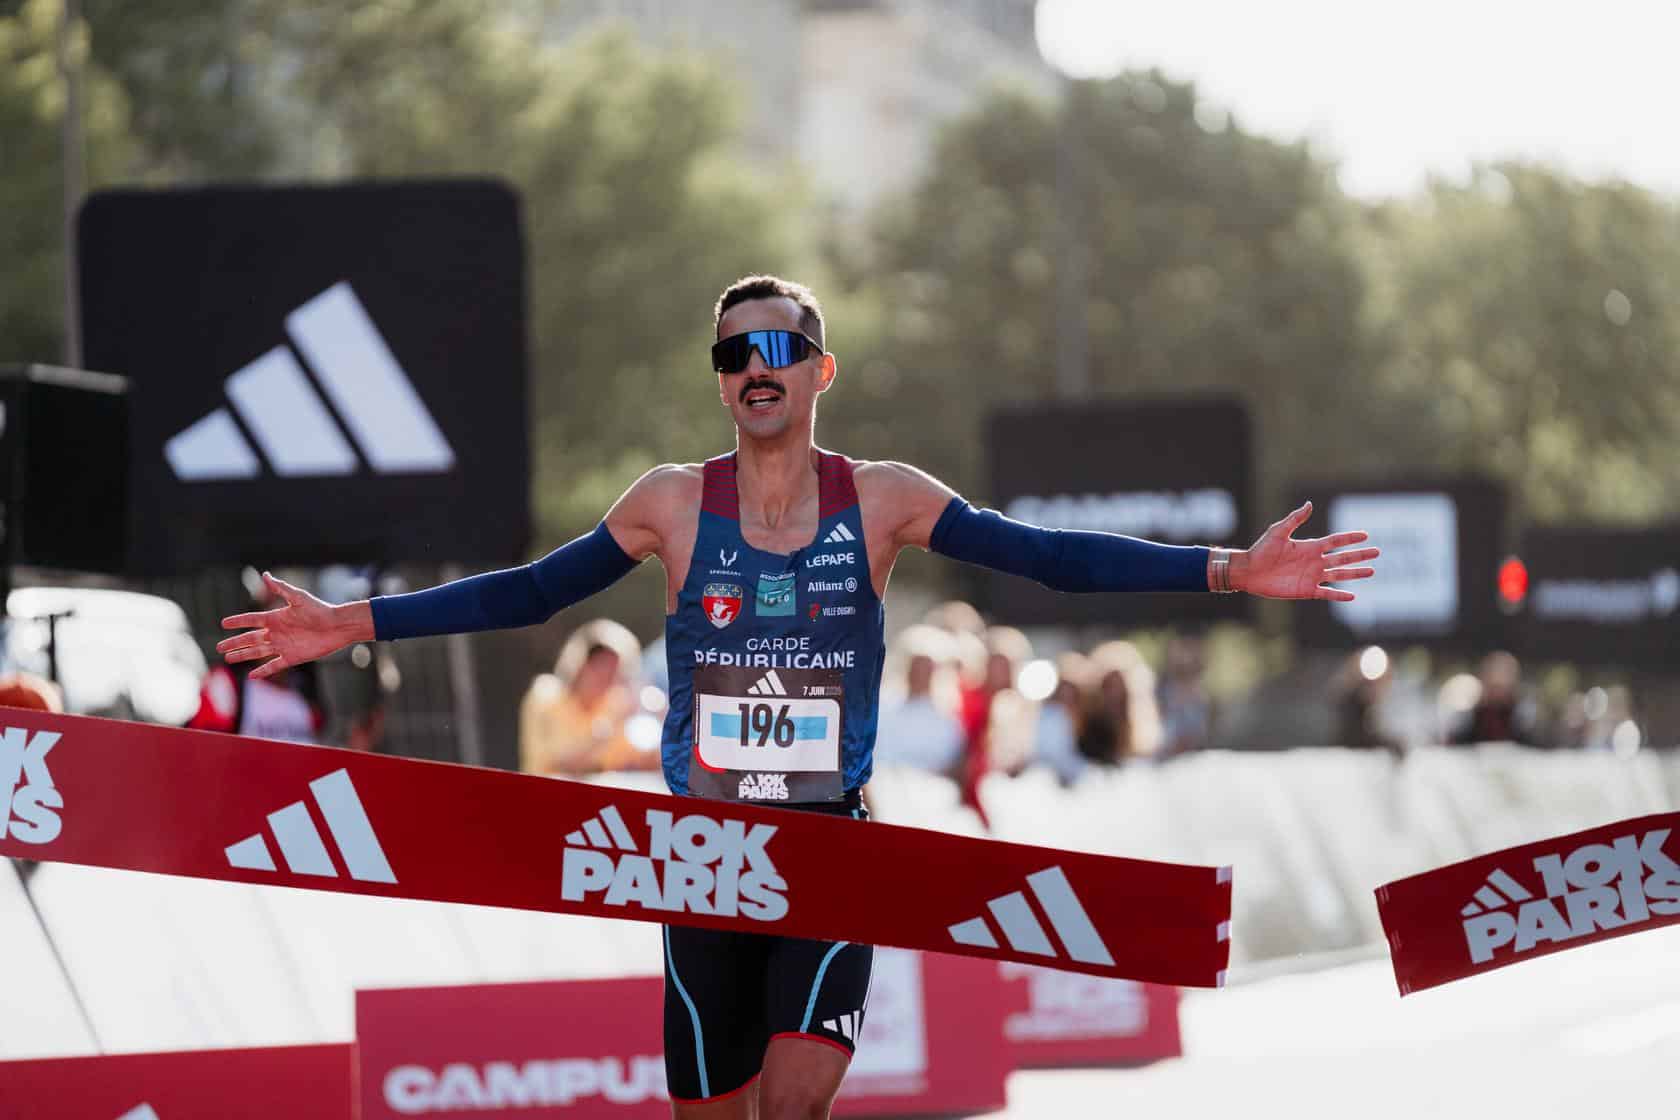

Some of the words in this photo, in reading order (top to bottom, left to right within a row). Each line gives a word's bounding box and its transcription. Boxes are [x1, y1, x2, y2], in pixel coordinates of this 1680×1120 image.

[806, 553, 855, 568] LEPAPE
[807, 581, 844, 593] Allianz
[746, 637, 810, 651] GARDE
[737, 703, 796, 748] 196
[738, 785, 789, 800] PARIS
[757, 774, 788, 787] 10K
[646, 809, 779, 874] 10K
[1533, 828, 1680, 898] 10K
[561, 847, 790, 921] PARIS
[1462, 872, 1680, 965] PARIS
[383, 1055, 668, 1114] CAMPU
